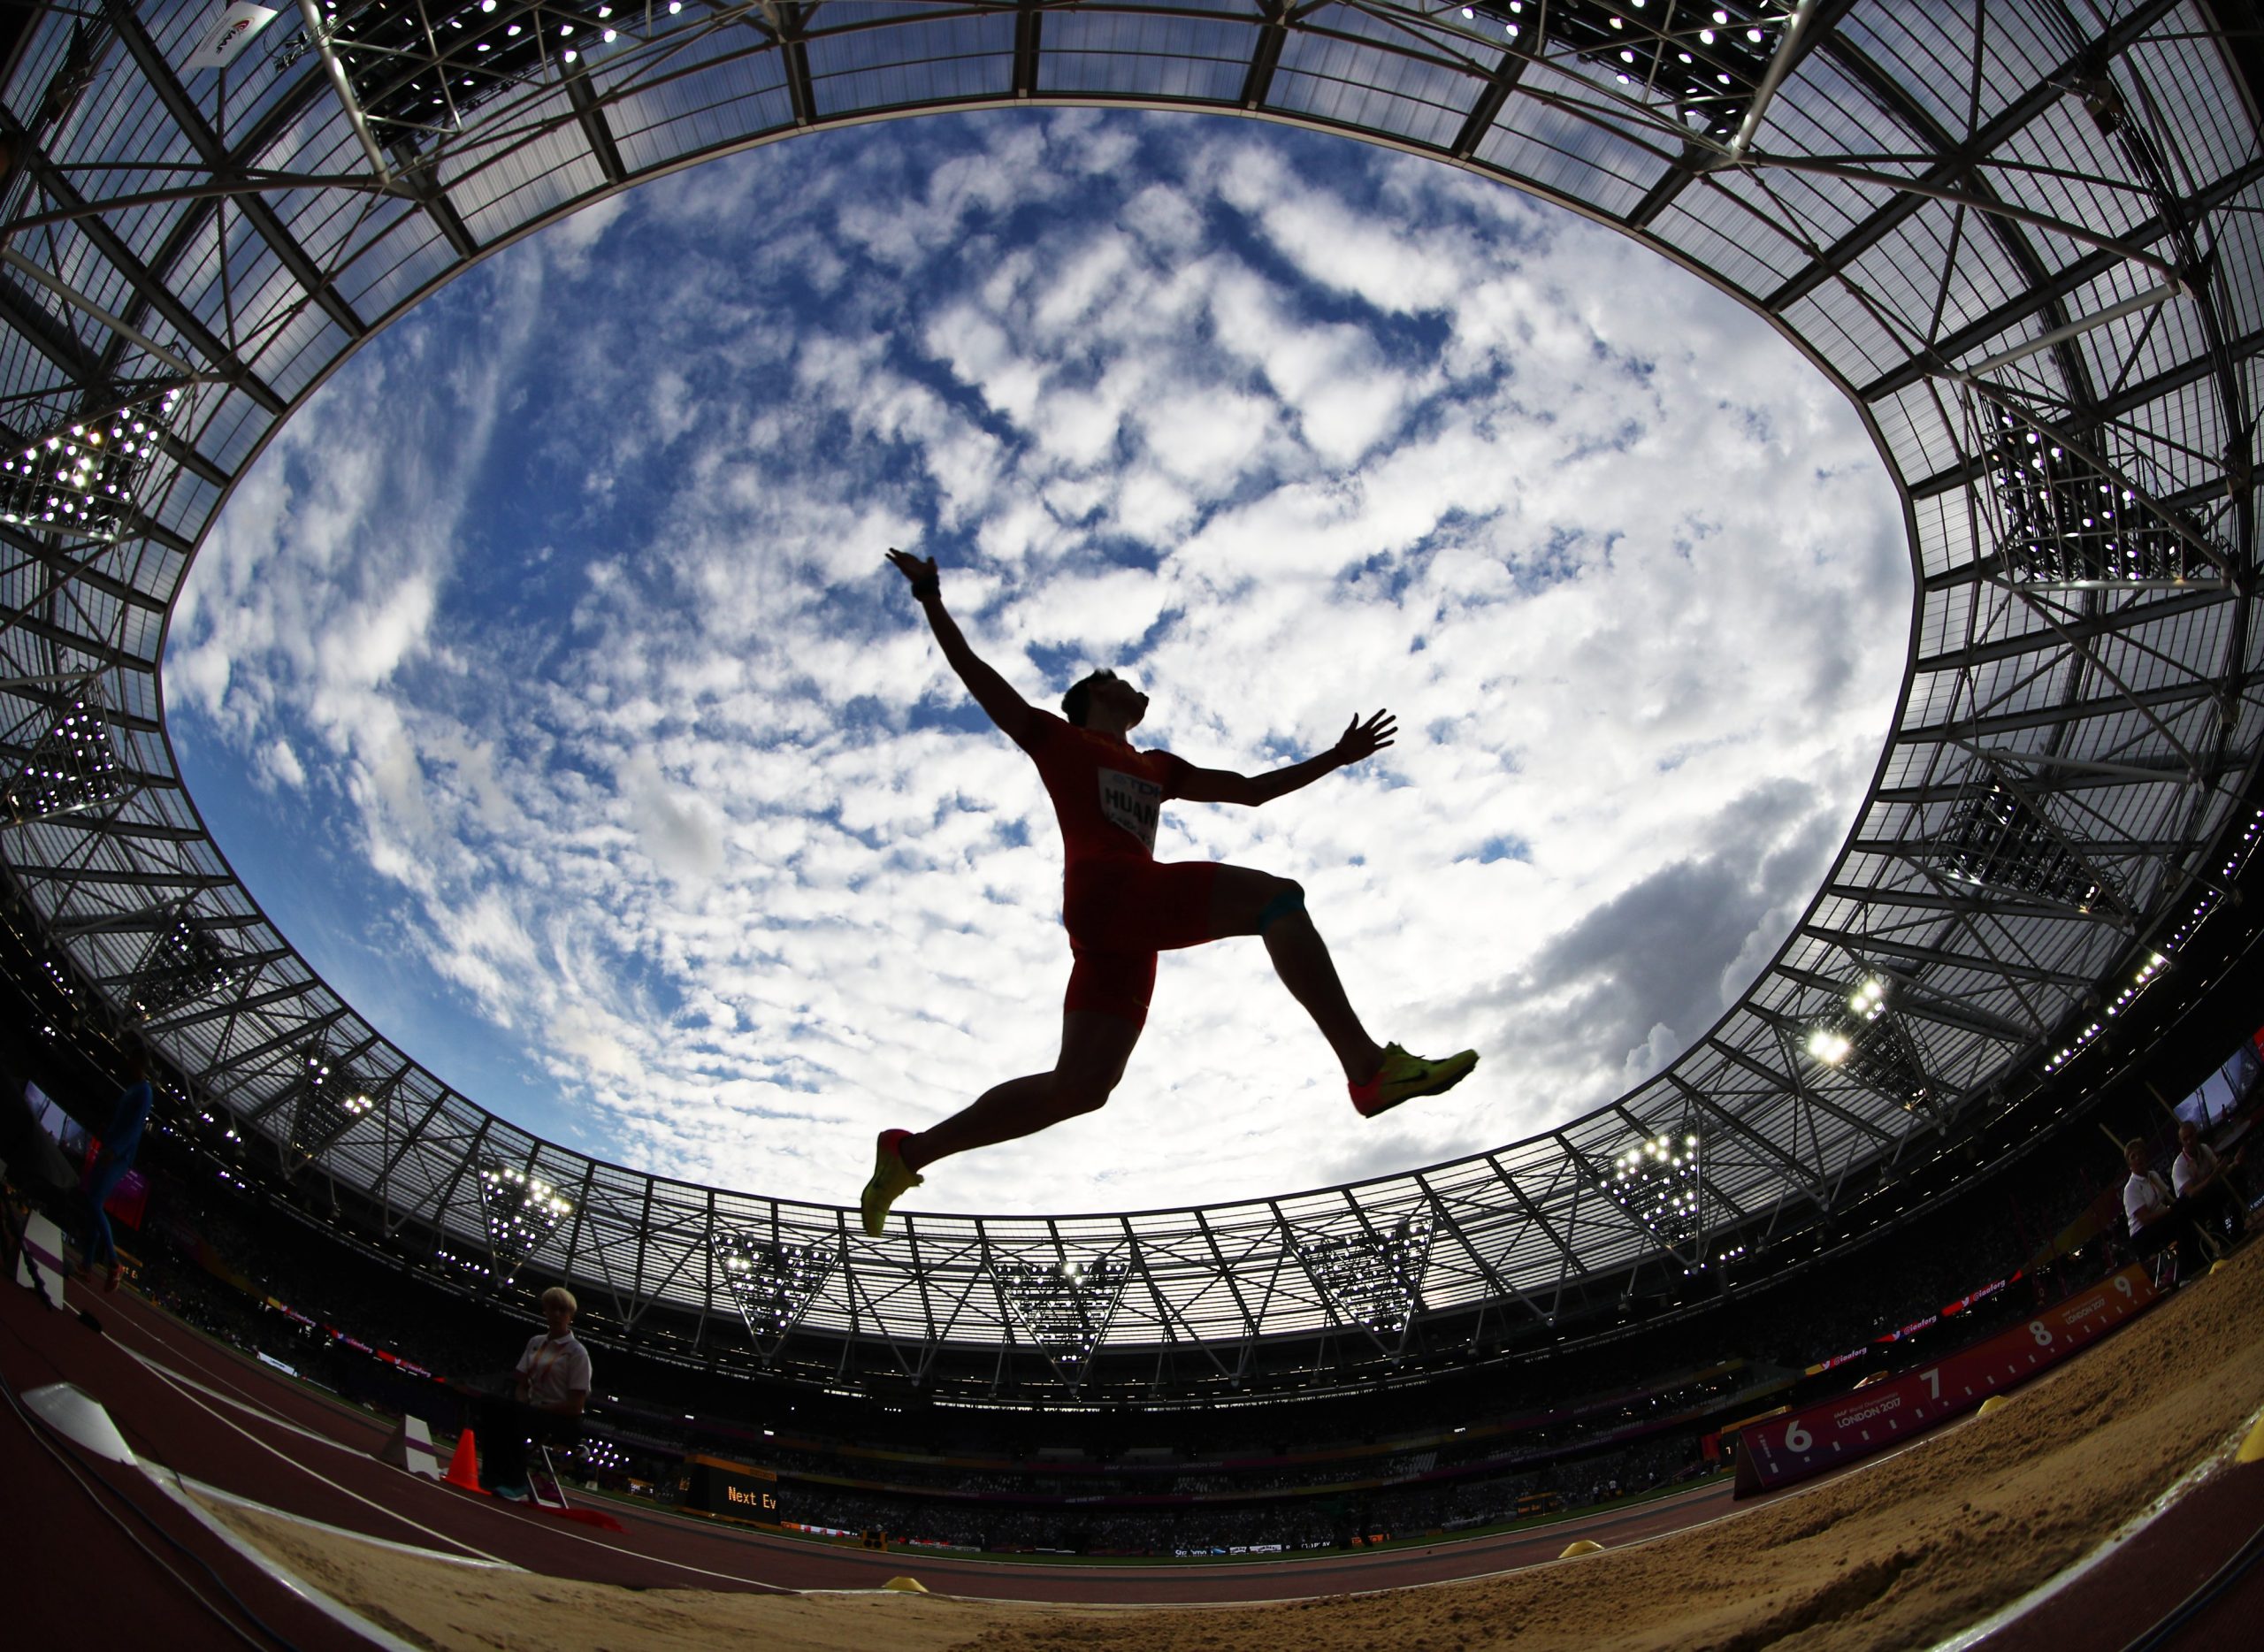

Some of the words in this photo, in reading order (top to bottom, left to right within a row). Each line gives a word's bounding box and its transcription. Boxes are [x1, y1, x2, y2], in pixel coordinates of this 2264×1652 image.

[216, 29, 239, 54] IAAF
[1105, 787, 1158, 829] HUAN
[1973, 1279, 2006, 1302] @iaaforg
[2114, 1275, 2132, 1298] 9
[1903, 1314, 1937, 1336] @iaaforg
[2065, 1306, 2093, 1326] LONDON
[2029, 1320, 2053, 1347] 8
[1833, 1346, 1867, 1365] @iaaforg
[1919, 1367, 1939, 1400] 7
[1836, 1406, 1880, 1429] LONDON
[1880, 1396, 1901, 1413] 2017
[1785, 1419, 1813, 1452] 6
[728, 1485, 757, 1507] Next
[762, 1494, 776, 1510] Ev
